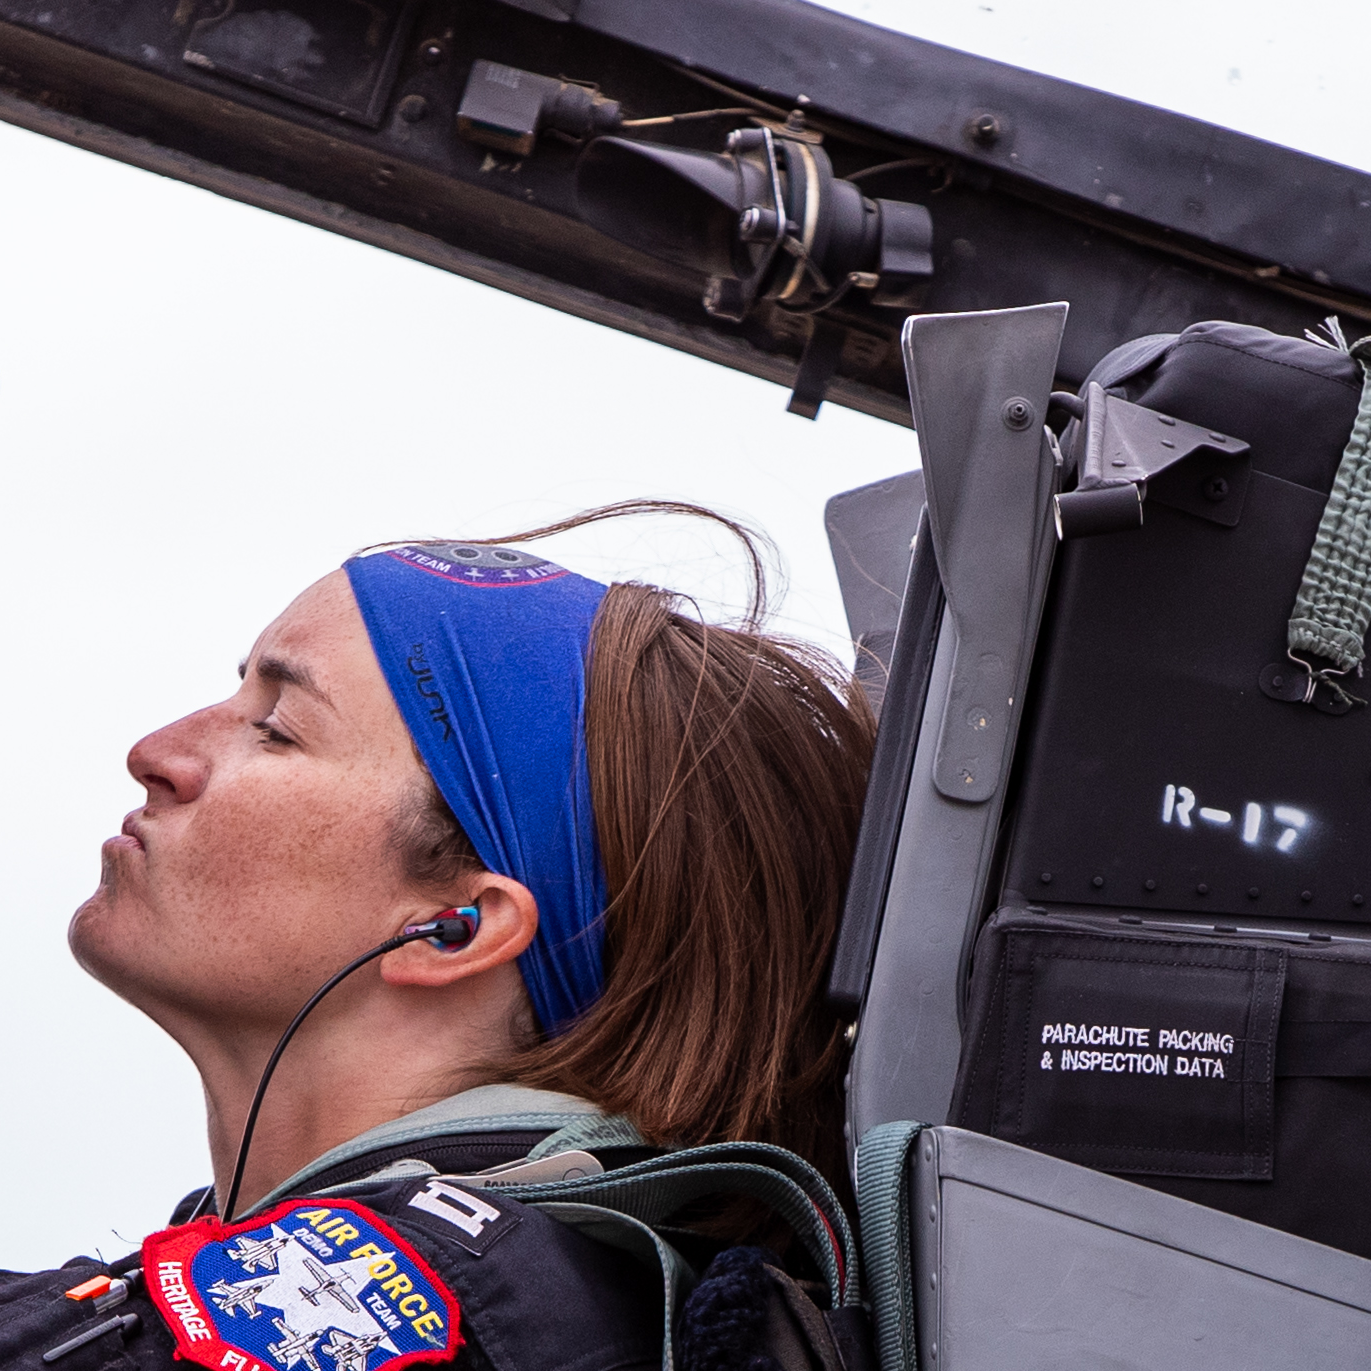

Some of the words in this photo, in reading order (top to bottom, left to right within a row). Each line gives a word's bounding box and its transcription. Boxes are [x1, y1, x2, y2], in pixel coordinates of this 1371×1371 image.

[1162, 783, 1307, 851] R-17
[1040, 1051, 1053, 1071] &
[1060, 1049, 1169, 1076] INSPECTION
[1173, 1056, 1226, 1079] DATA
[1041, 1022, 1151, 1048] PARACHUTE
[1158, 1029, 1235, 1053] PACKING
[158, 1261, 212, 1342] HERITAGE
[292, 1228, 334, 1258] DEMO
[365, 1292, 404, 1331] TEAM
[296, 1208, 360, 1246] AIR
[349, 1242, 444, 1338] FORCE
